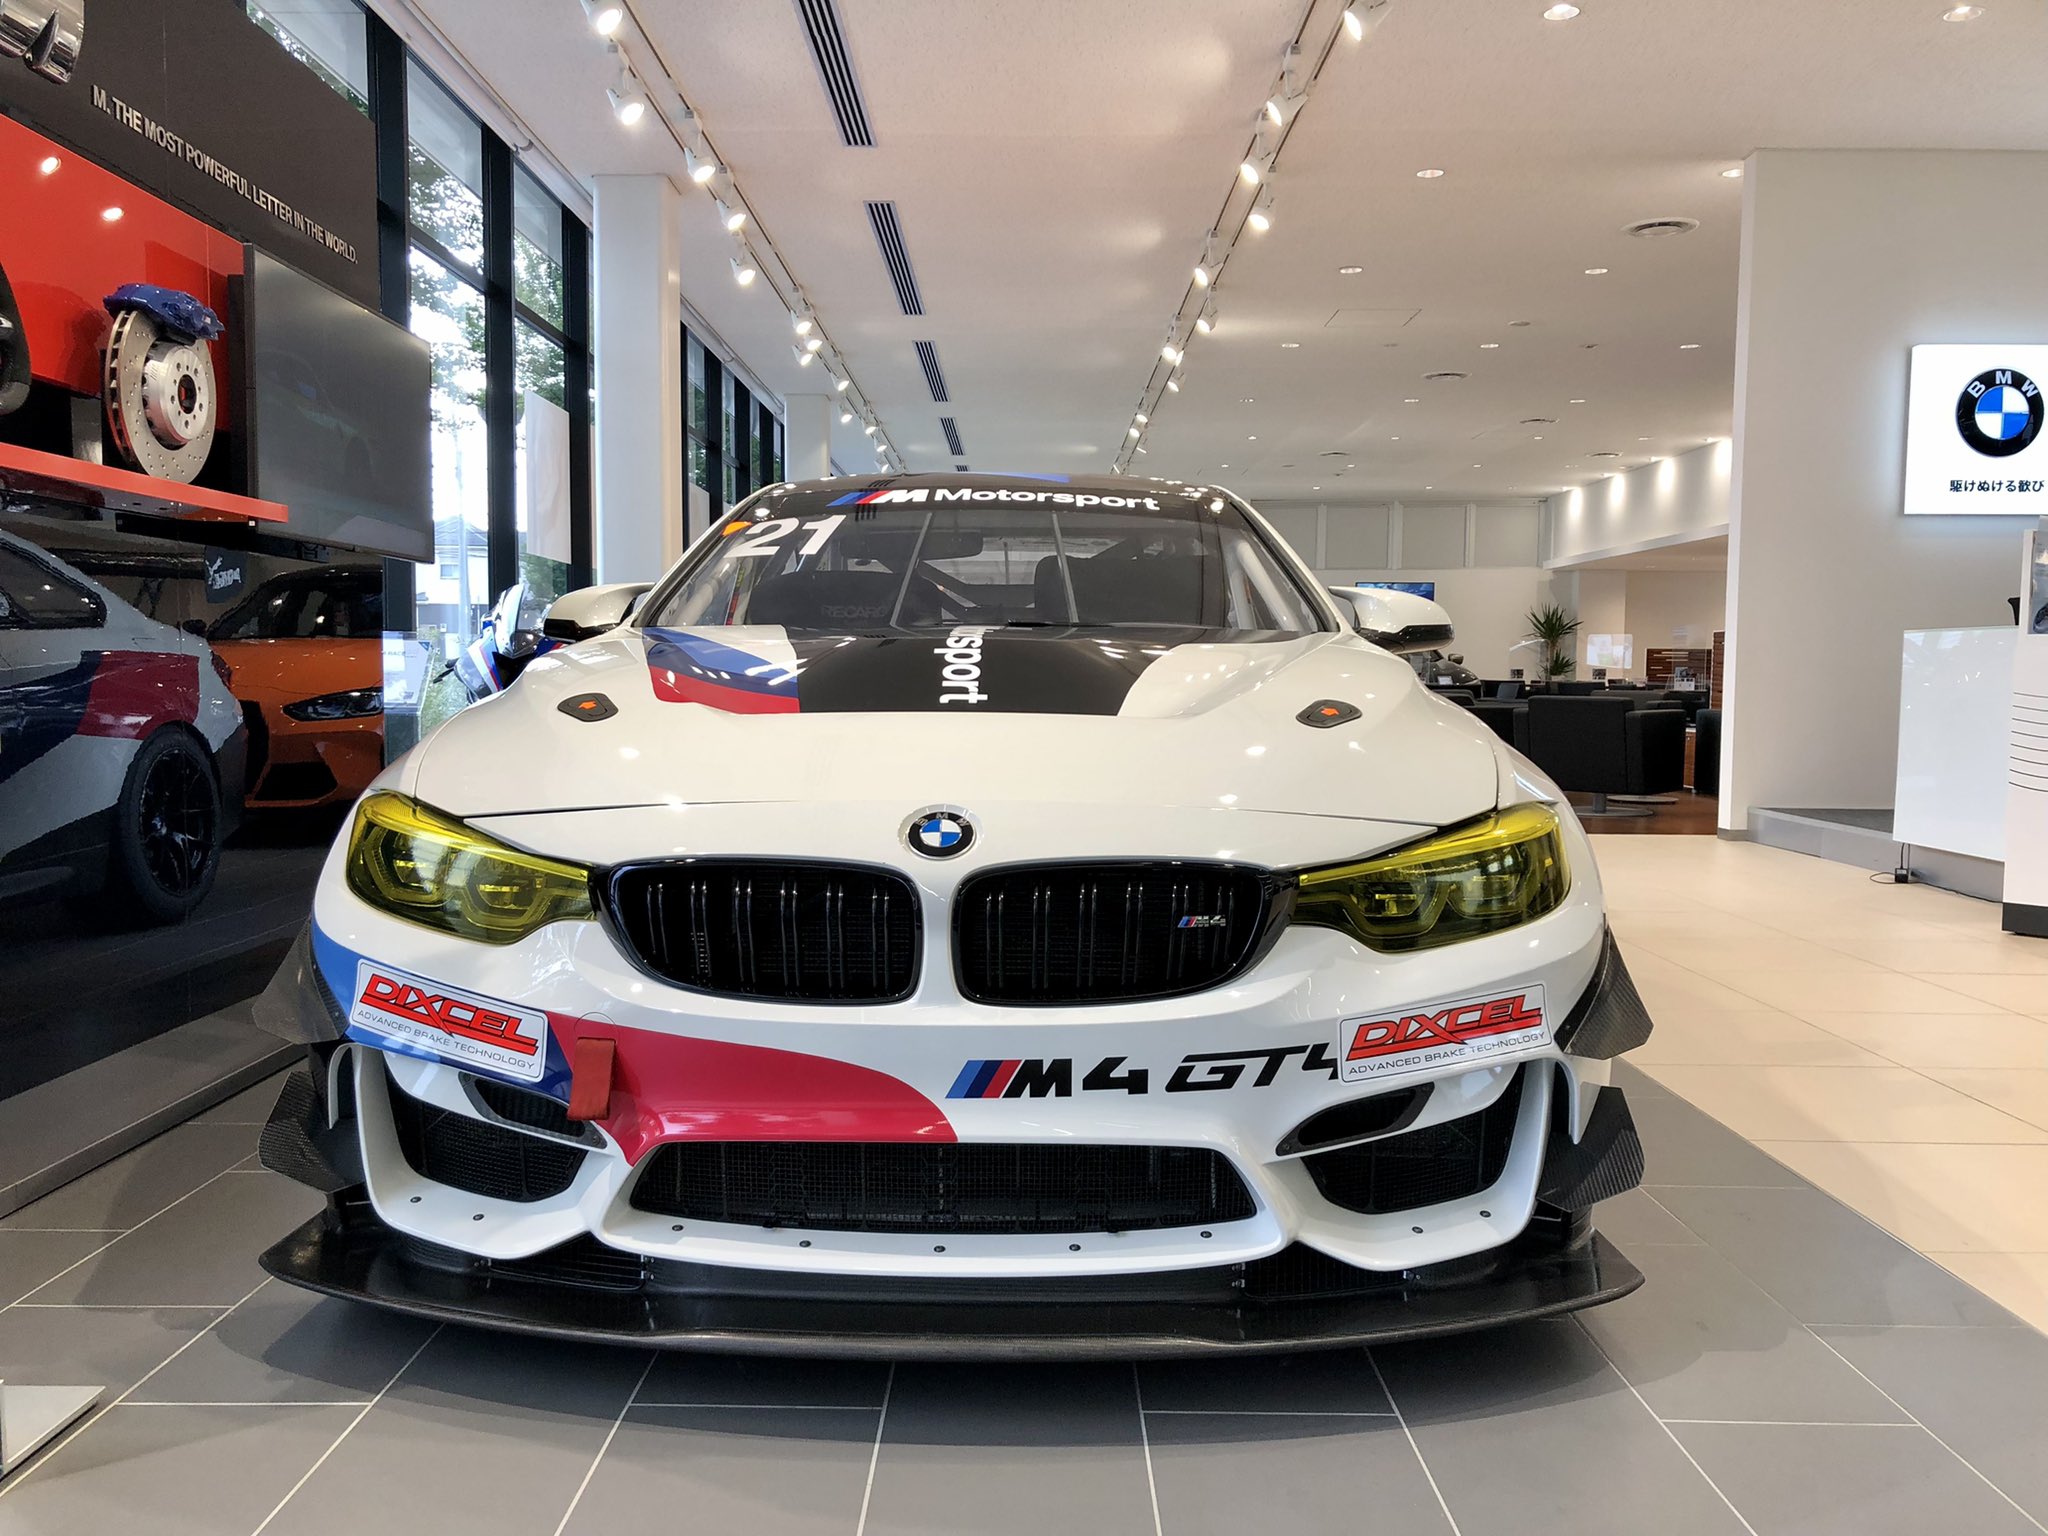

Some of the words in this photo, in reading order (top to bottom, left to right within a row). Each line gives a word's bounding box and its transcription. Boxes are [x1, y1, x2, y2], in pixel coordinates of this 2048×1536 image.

[92, 84, 111, 115] M.
[112, 96, 143, 134] THE
[143, 117, 184, 158] MOST
[184, 142, 251, 200] POWERFUL
[252, 185, 292, 224] LETTER
[293, 210, 304, 231] IN
[304, 217, 324, 243] THE
[323, 229, 358, 264] WORLD.
[1967, 370, 2039, 400] BMW
[933, 488, 1160, 511] Motorsport
[1949, 479, 2045, 493] 駆けぬける歓び
[723, 515, 847, 558] 21
[360, 974, 538, 1056] DIXCEL
[1345, 994, 1543, 1061] DIXCEL
[357, 1009, 412, 1034] ADVANCED
[413, 1028, 450, 1047] BRAKE
[454, 1040, 535, 1070] TECHNOLOGY
[1349, 1056, 1422, 1075] ADVANCED
[1425, 1047, 1467, 1063] BRAKE
[1470, 1031, 1545, 1054] TECHNOLOGY
